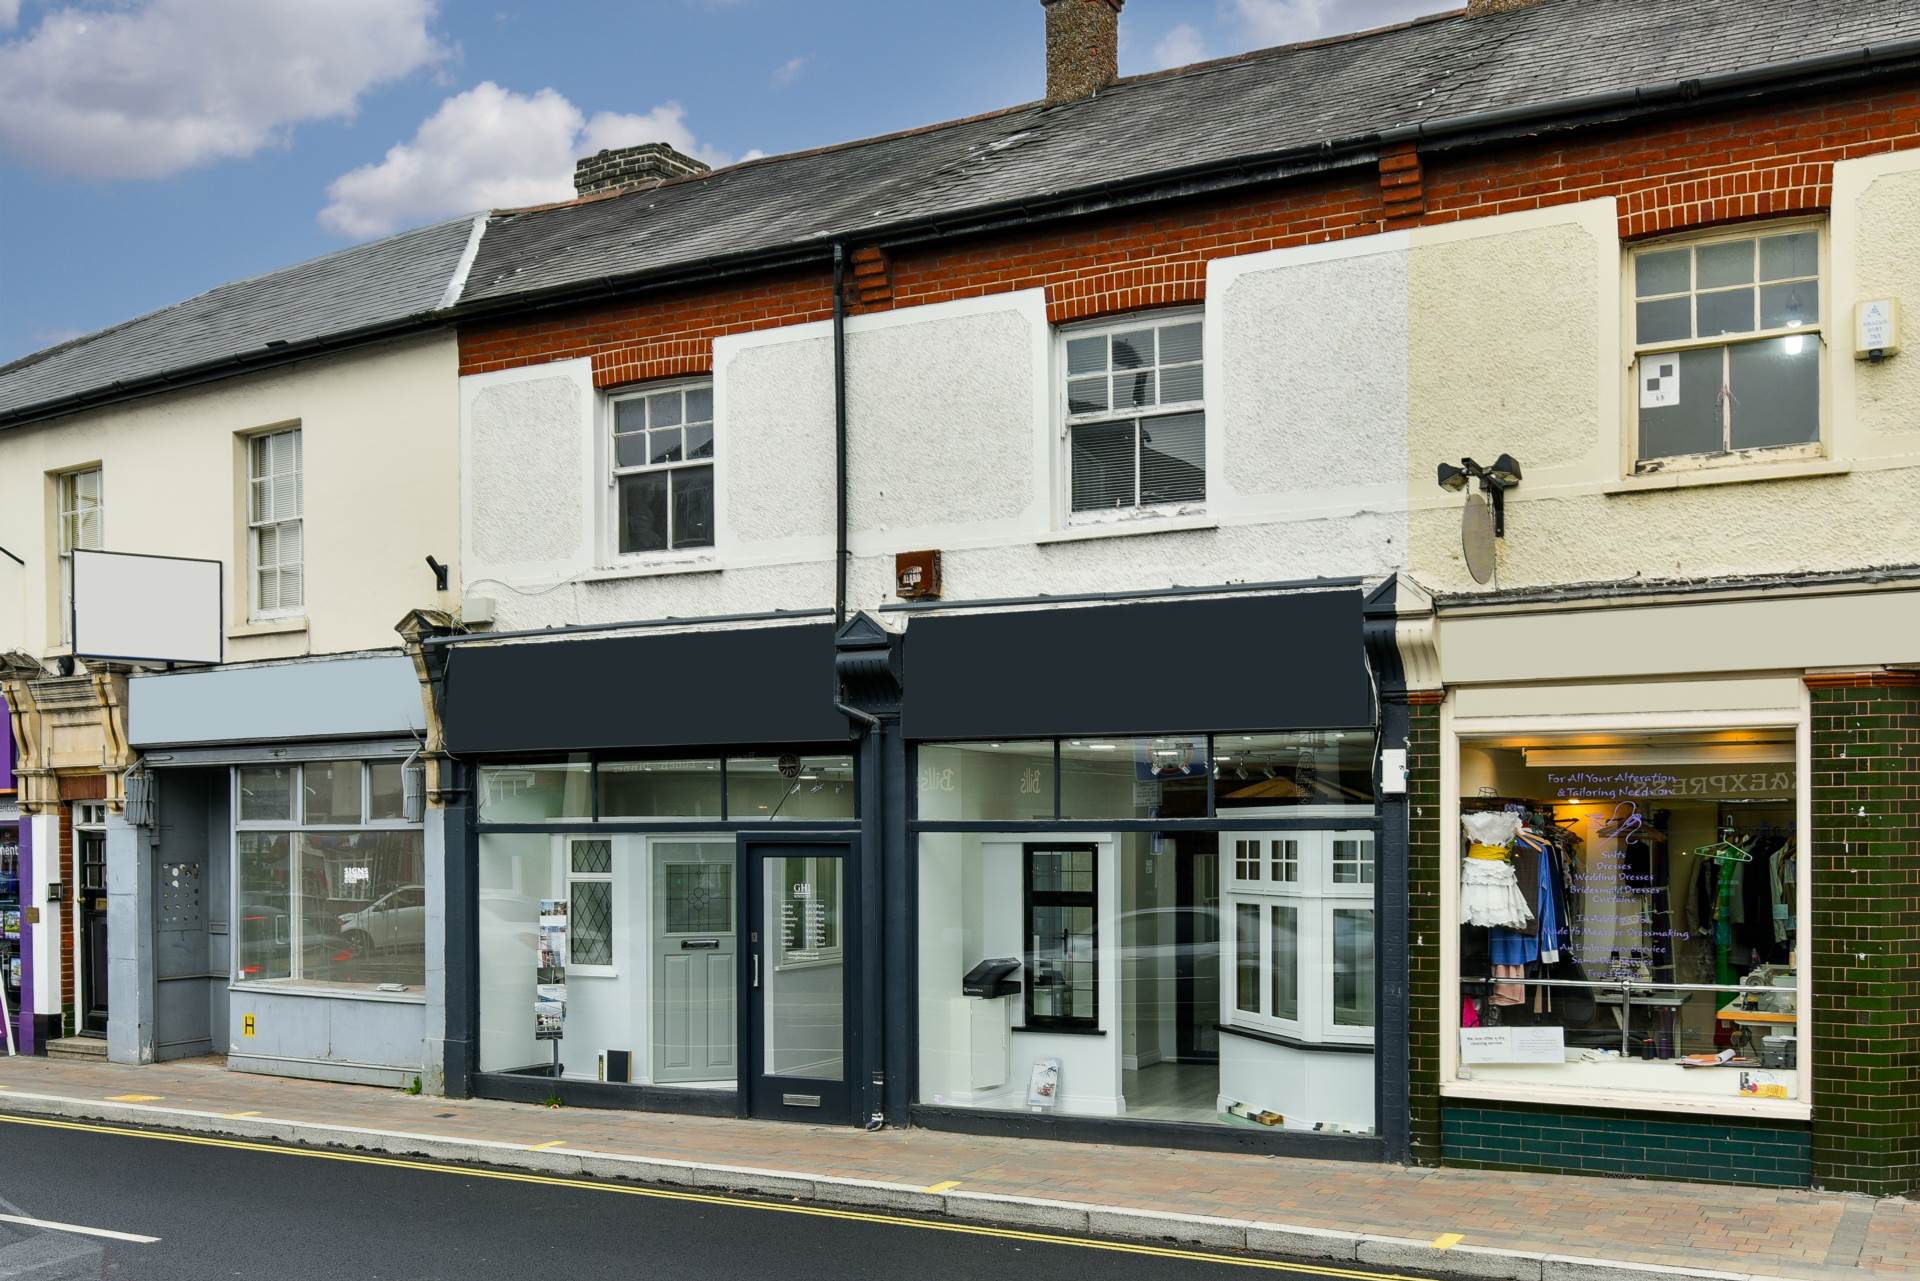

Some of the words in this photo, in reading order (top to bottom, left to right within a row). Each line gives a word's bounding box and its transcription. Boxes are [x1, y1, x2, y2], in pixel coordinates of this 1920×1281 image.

[1547, 774, 1564, 783] For
[1567, 773, 1584, 783] All
[1586, 773, 1611, 783] Your
[1614, 771, 1676, 784] Alteration
[1557, 788, 1566, 798] &
[1567, 786, 1616, 799] Tailoring
[1618, 786, 1654, 798] Needs
[1601, 850, 1626, 859] Suits
[1596, 863, 1633, 871] Dresses
[1574, 873, 1617, 883] Wedding
[1619, 873, 1655, 881] Dresses
[1625, 885, 1661, 894] Dresses
[244, 1015, 255, 1035] H
